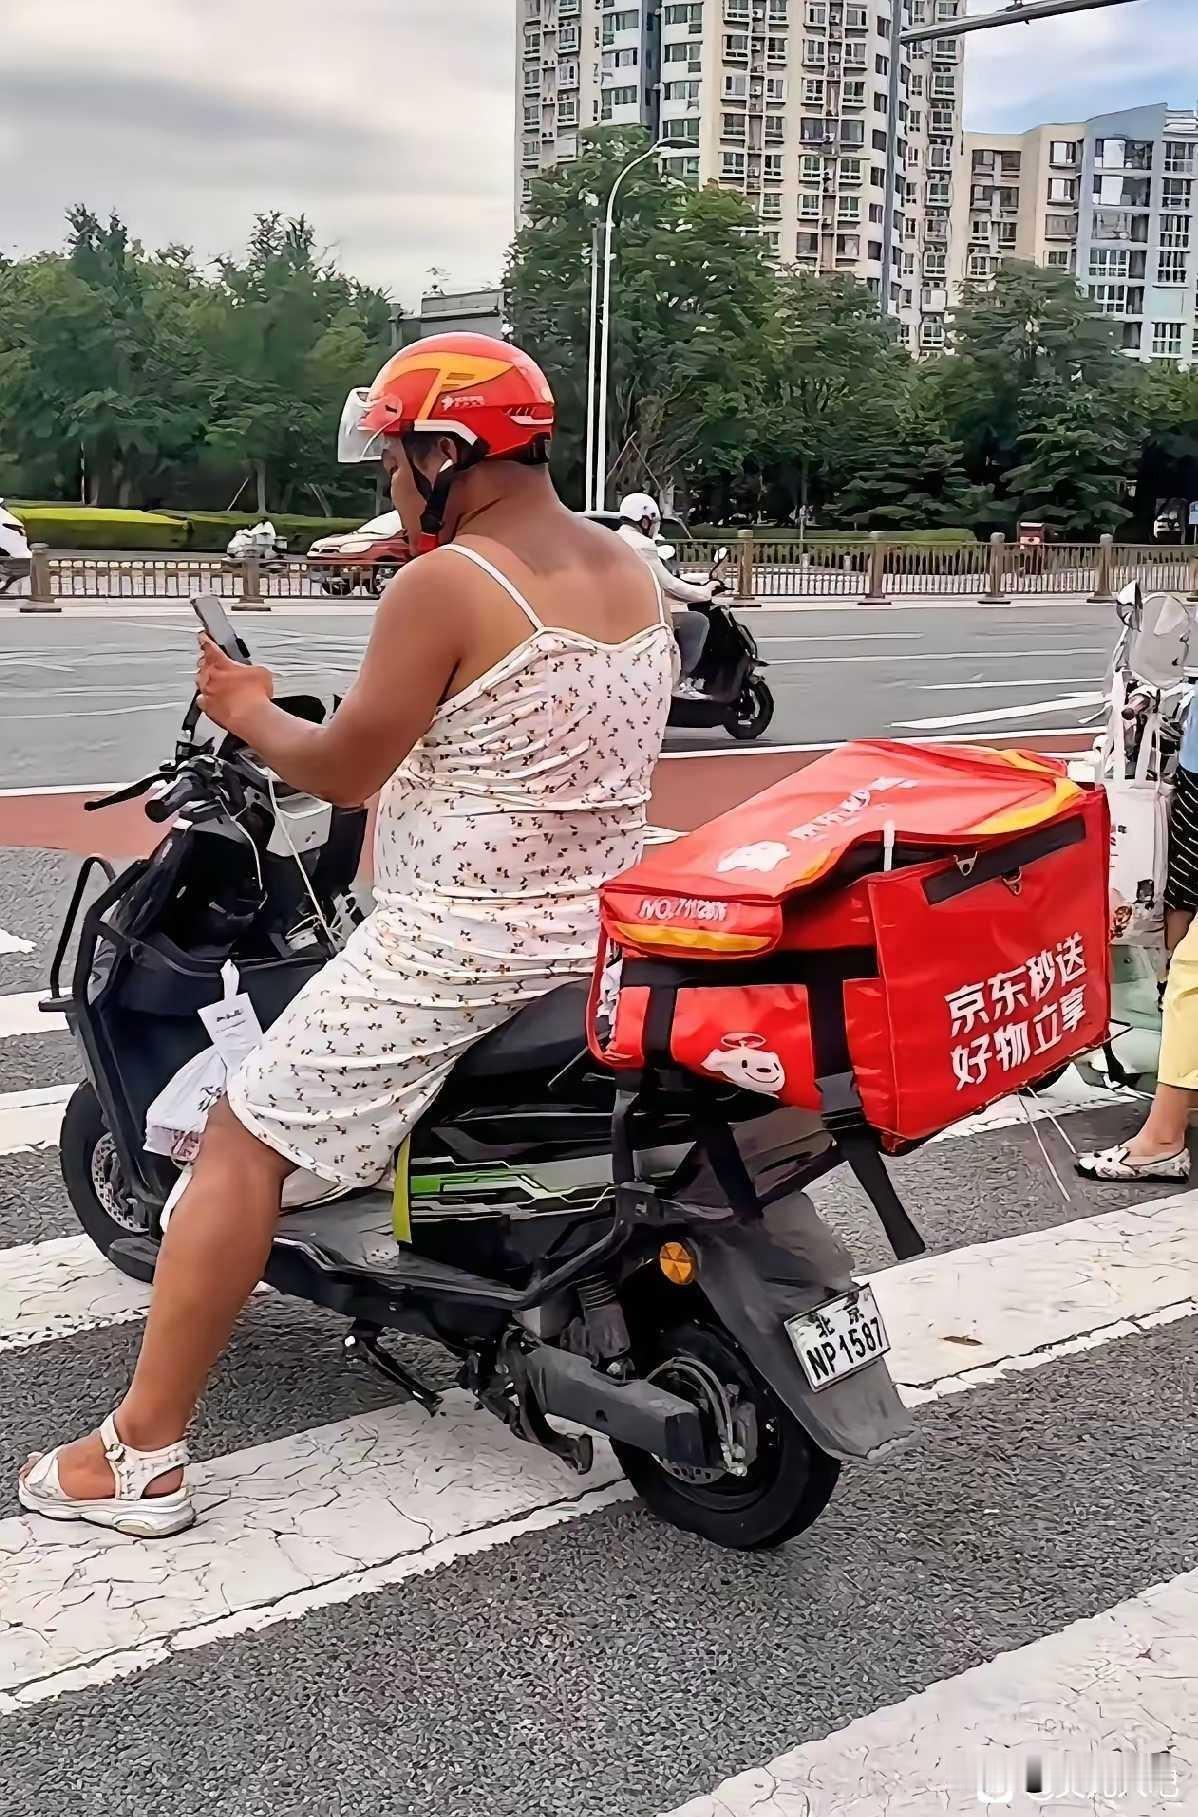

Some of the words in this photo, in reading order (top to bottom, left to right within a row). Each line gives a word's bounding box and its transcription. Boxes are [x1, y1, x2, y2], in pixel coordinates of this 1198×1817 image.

[944, 931, 1087, 1037] 京东秒送
[950, 983, 1087, 1091] 好物立享
[806, 1317, 883, 1380] NP1587
